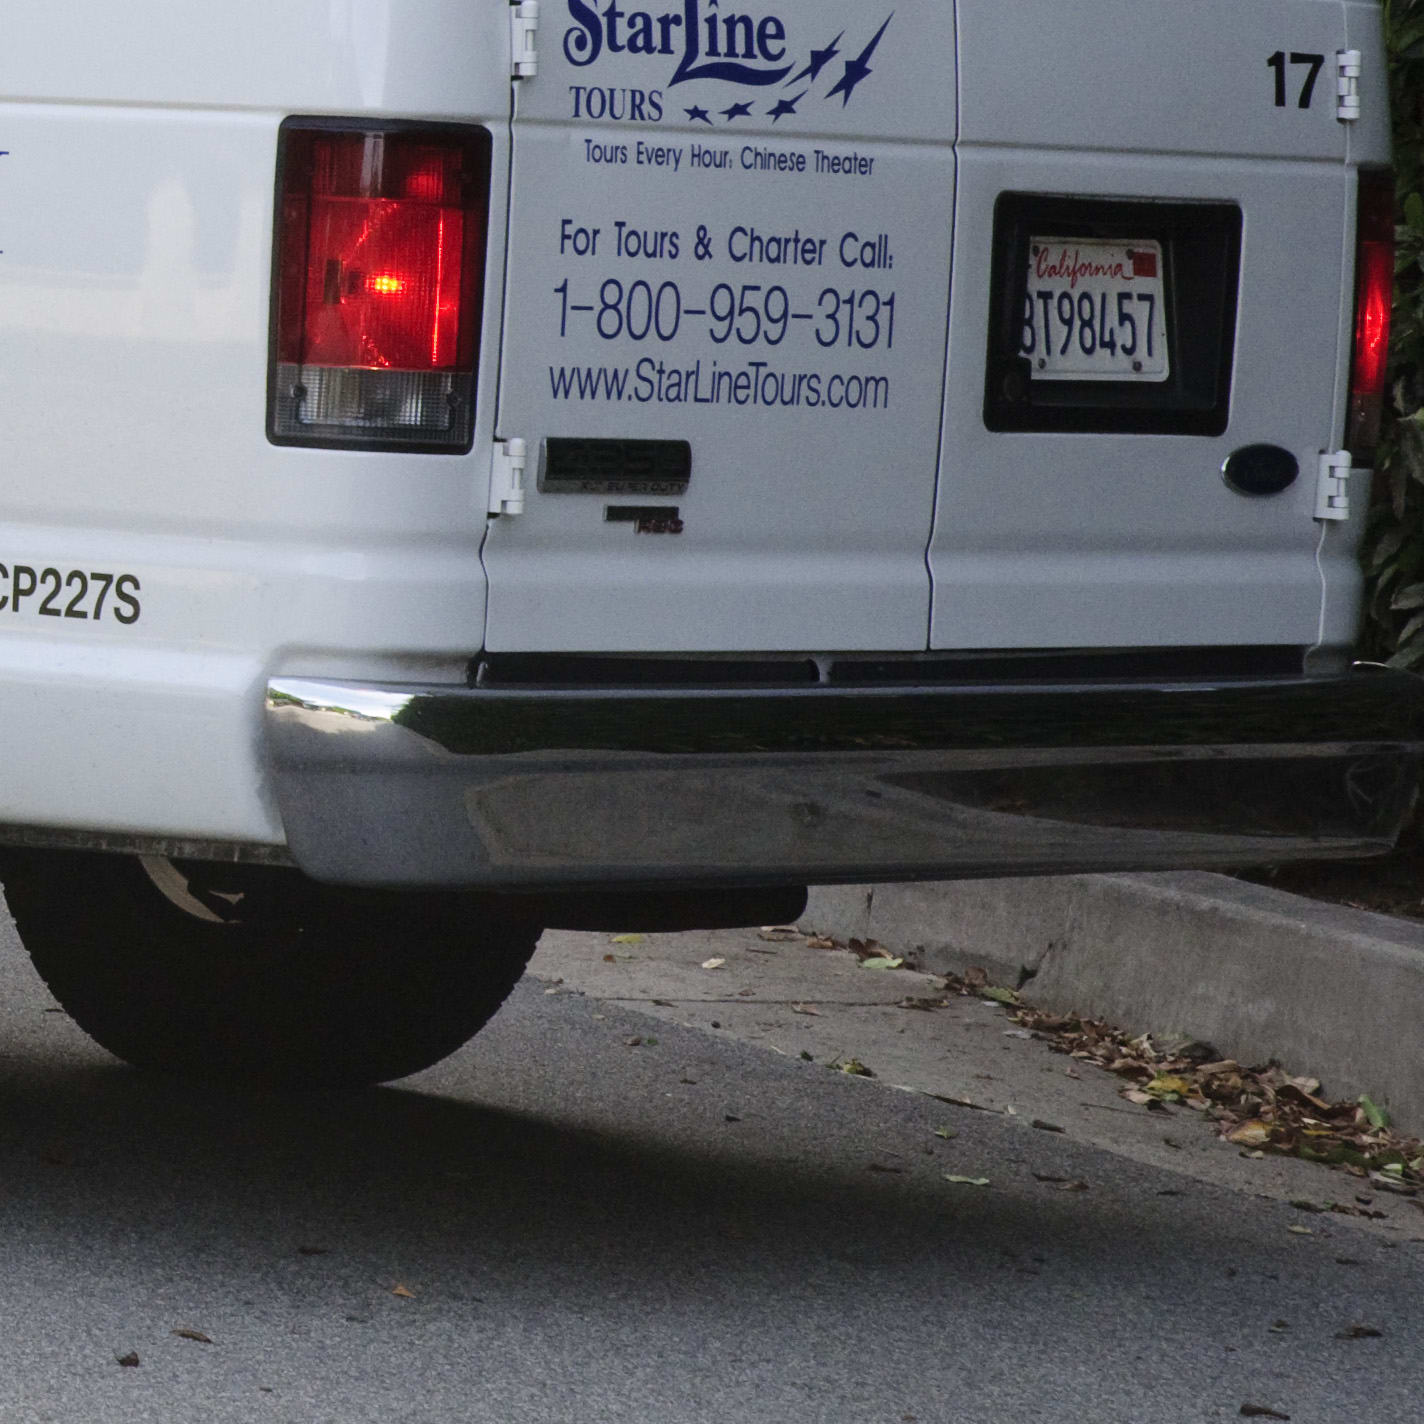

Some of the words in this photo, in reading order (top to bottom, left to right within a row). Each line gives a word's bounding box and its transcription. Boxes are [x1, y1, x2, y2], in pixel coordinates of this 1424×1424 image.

[569, 85, 664, 122] TOURS
[1267, 50, 1326, 109] 17
[585, 138, 628, 165] Tours
[636, 140, 683, 172] Every
[740, 145, 806, 173] Chinese
[814, 149, 875, 176] Theater
[560, 218, 601, 256] For
[614, 221, 680, 260] Tours
[693, 224, 713, 261] &
[728, 225, 827, 266] Charter
[1036, 247, 1136, 289] California
[553, 277, 896, 350] 1-800-959-3131
[549, 356, 890, 409] www.StarLineTours.com
